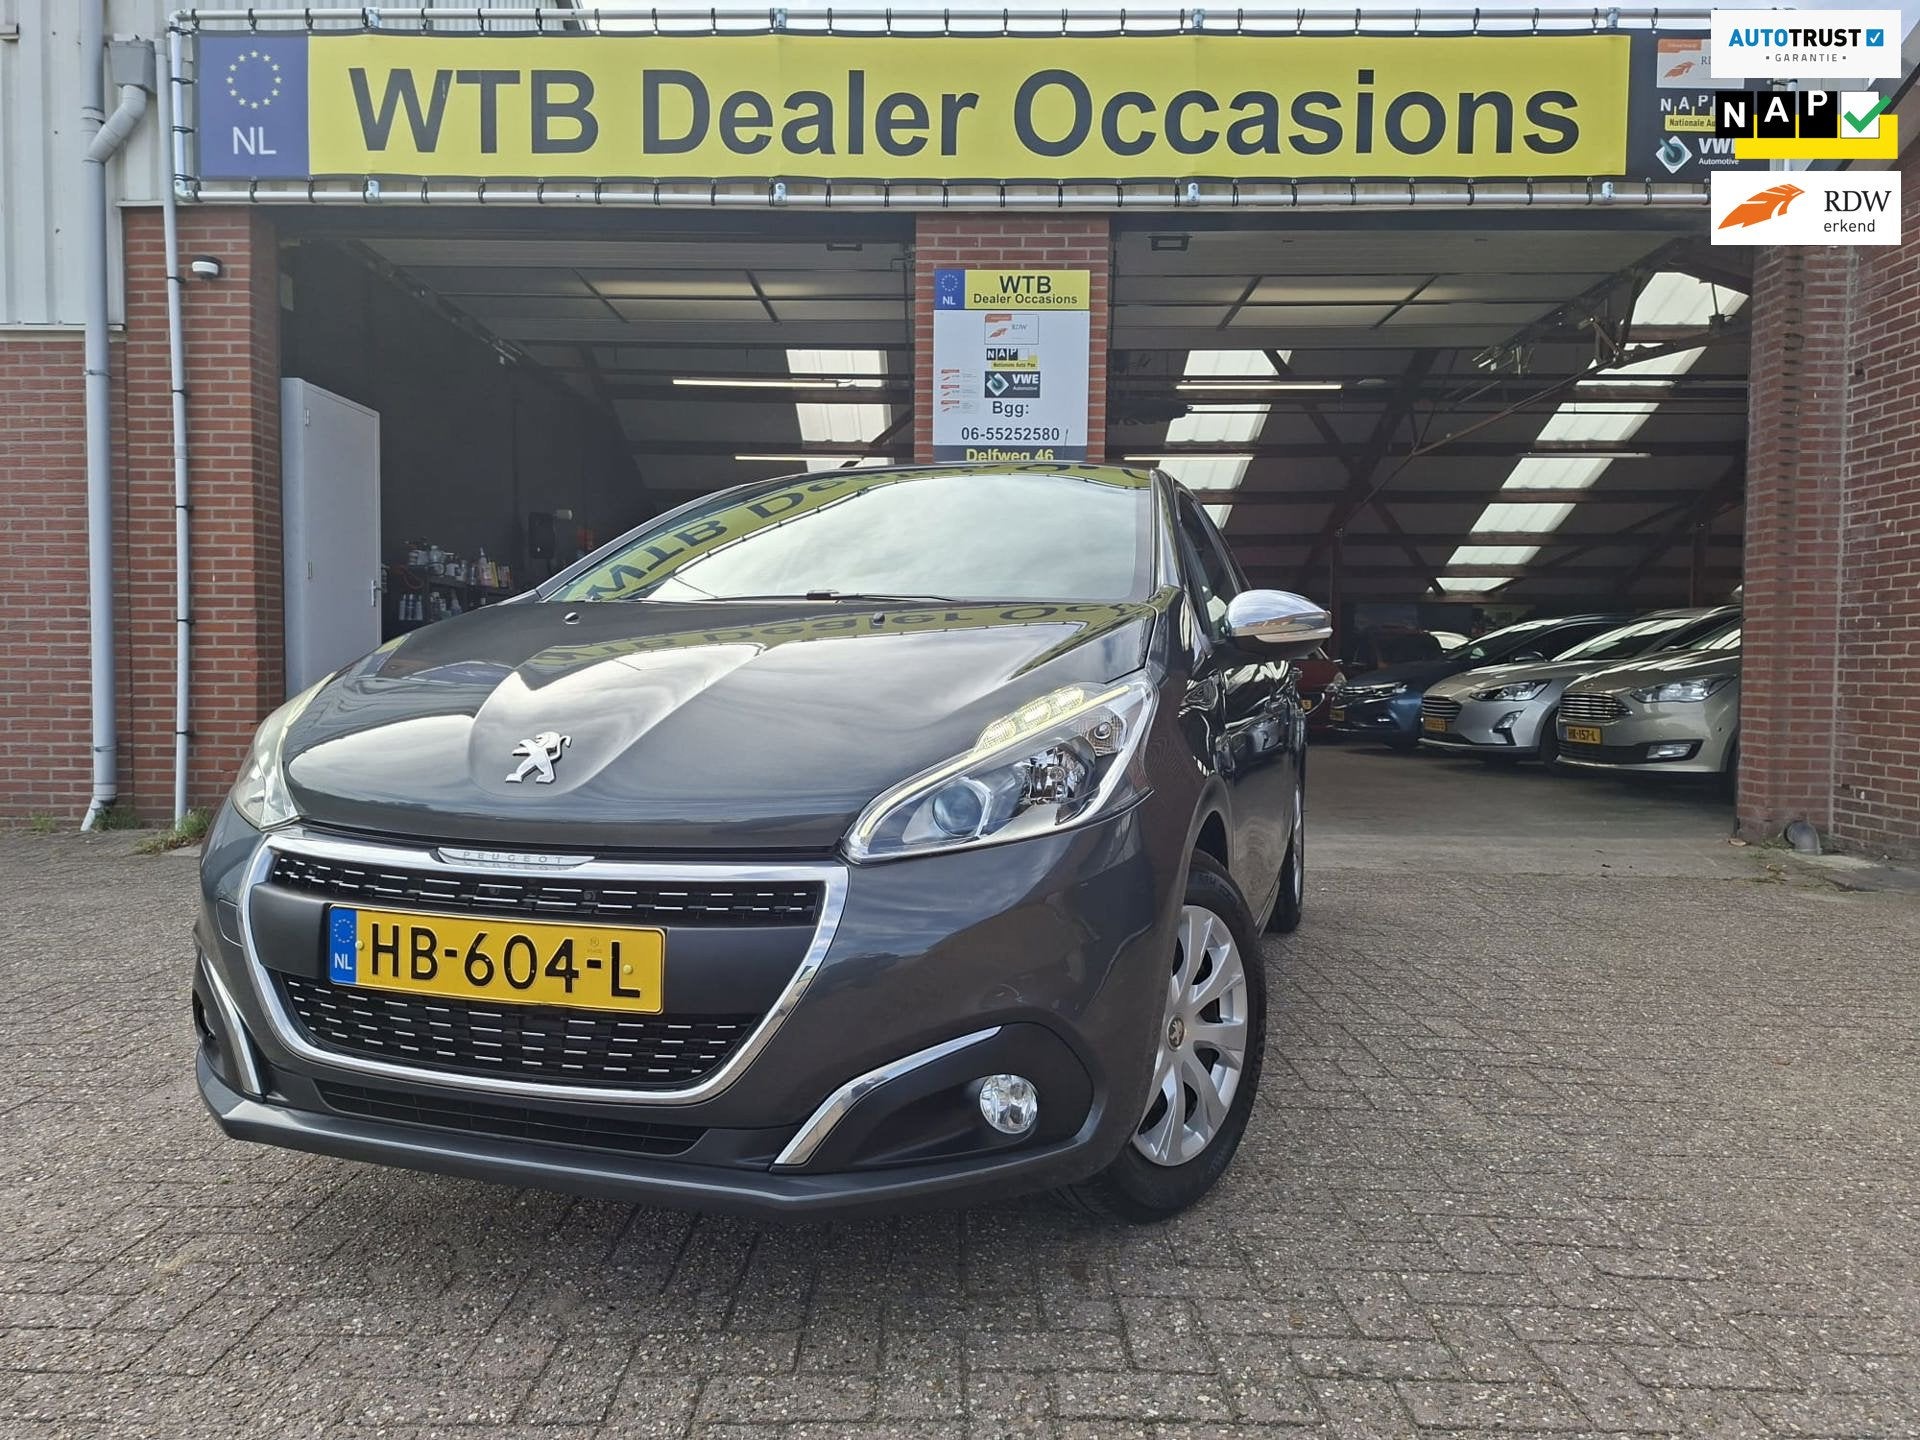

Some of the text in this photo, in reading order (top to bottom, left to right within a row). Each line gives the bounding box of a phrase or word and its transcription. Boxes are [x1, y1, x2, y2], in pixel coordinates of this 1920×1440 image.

[348, 67, 1580, 157] WTB Dealer Occasions
[1669, 118, 1705, 127] Nationale
[232, 126, 277, 156] NL
[1000, 275, 1052, 294] WTB
[942, 296, 956, 306] NL
[973, 293, 1078, 305] Dealer Occasions
[1012, 374, 1039, 384] VWE
[992, 401, 1030, 418] Bgg:
[961, 427, 1060, 441] 06-55252580
[966, 448, 1054, 461] Delfweg 46
[463, 850, 564, 865] PEUGEOT
[333, 952, 353, 970] NL
[371, 922, 641, 999] HB-604-L
